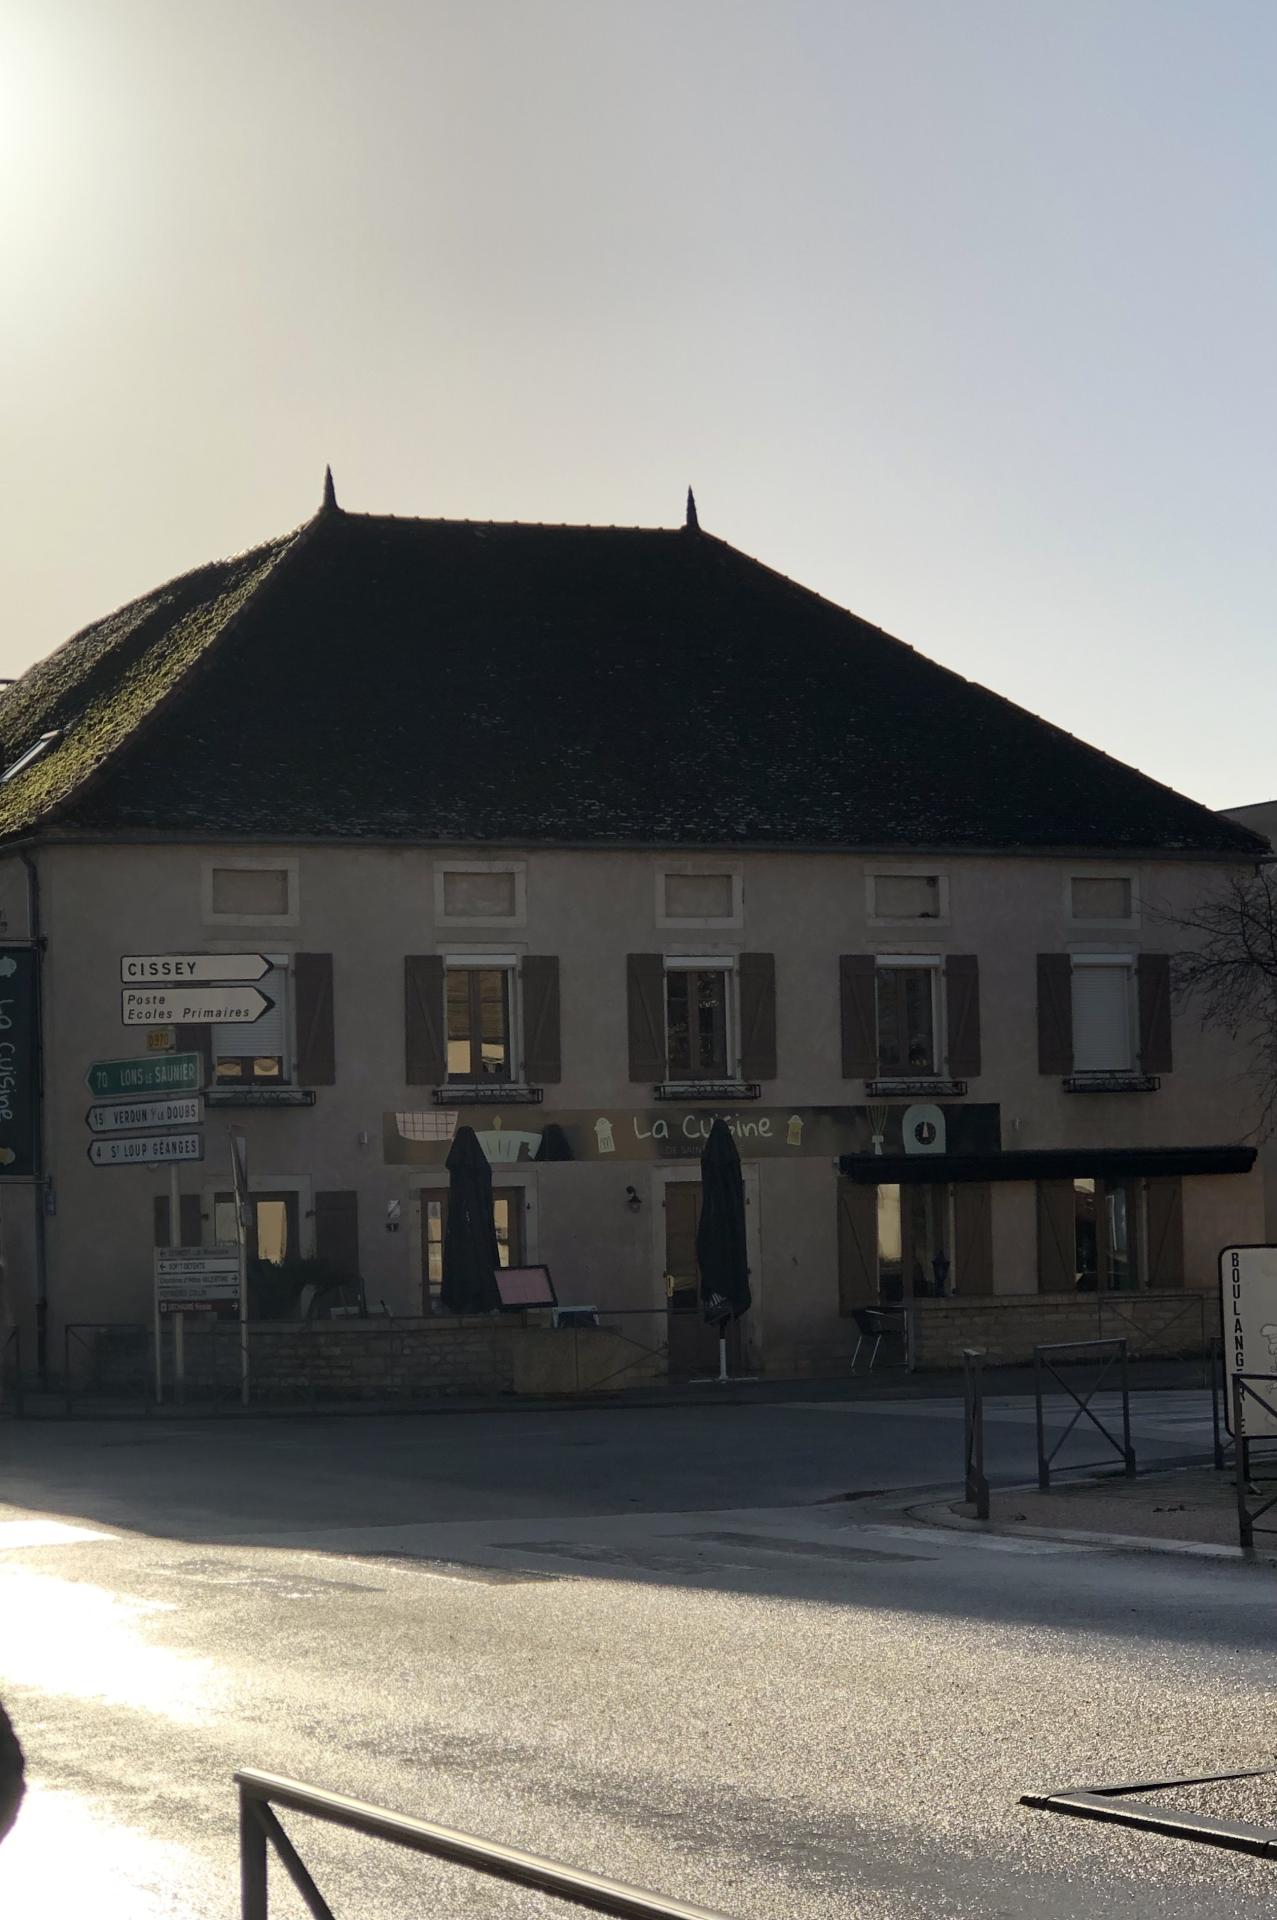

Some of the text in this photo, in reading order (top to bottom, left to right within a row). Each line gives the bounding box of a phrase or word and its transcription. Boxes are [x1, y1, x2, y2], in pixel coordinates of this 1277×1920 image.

[127, 962, 197, 977] CISSEY
[127, 994, 166, 1005] Poste
[127, 1007, 250, 1020] Ecoles Primaires
[96, 1063, 196, 1088] 70 LONS LE SAUNIER
[94, 1111, 104, 1126] 15
[113, 1109, 148, 1125] VERDUN
[166, 1104, 197, 1120] DOUBS
[633, 1112, 773, 1140] La Cusine
[96, 1145, 102, 1158] 4
[124, 1143, 147, 1158] LOUP
[152, 1139, 197, 1157] GÉANGES
